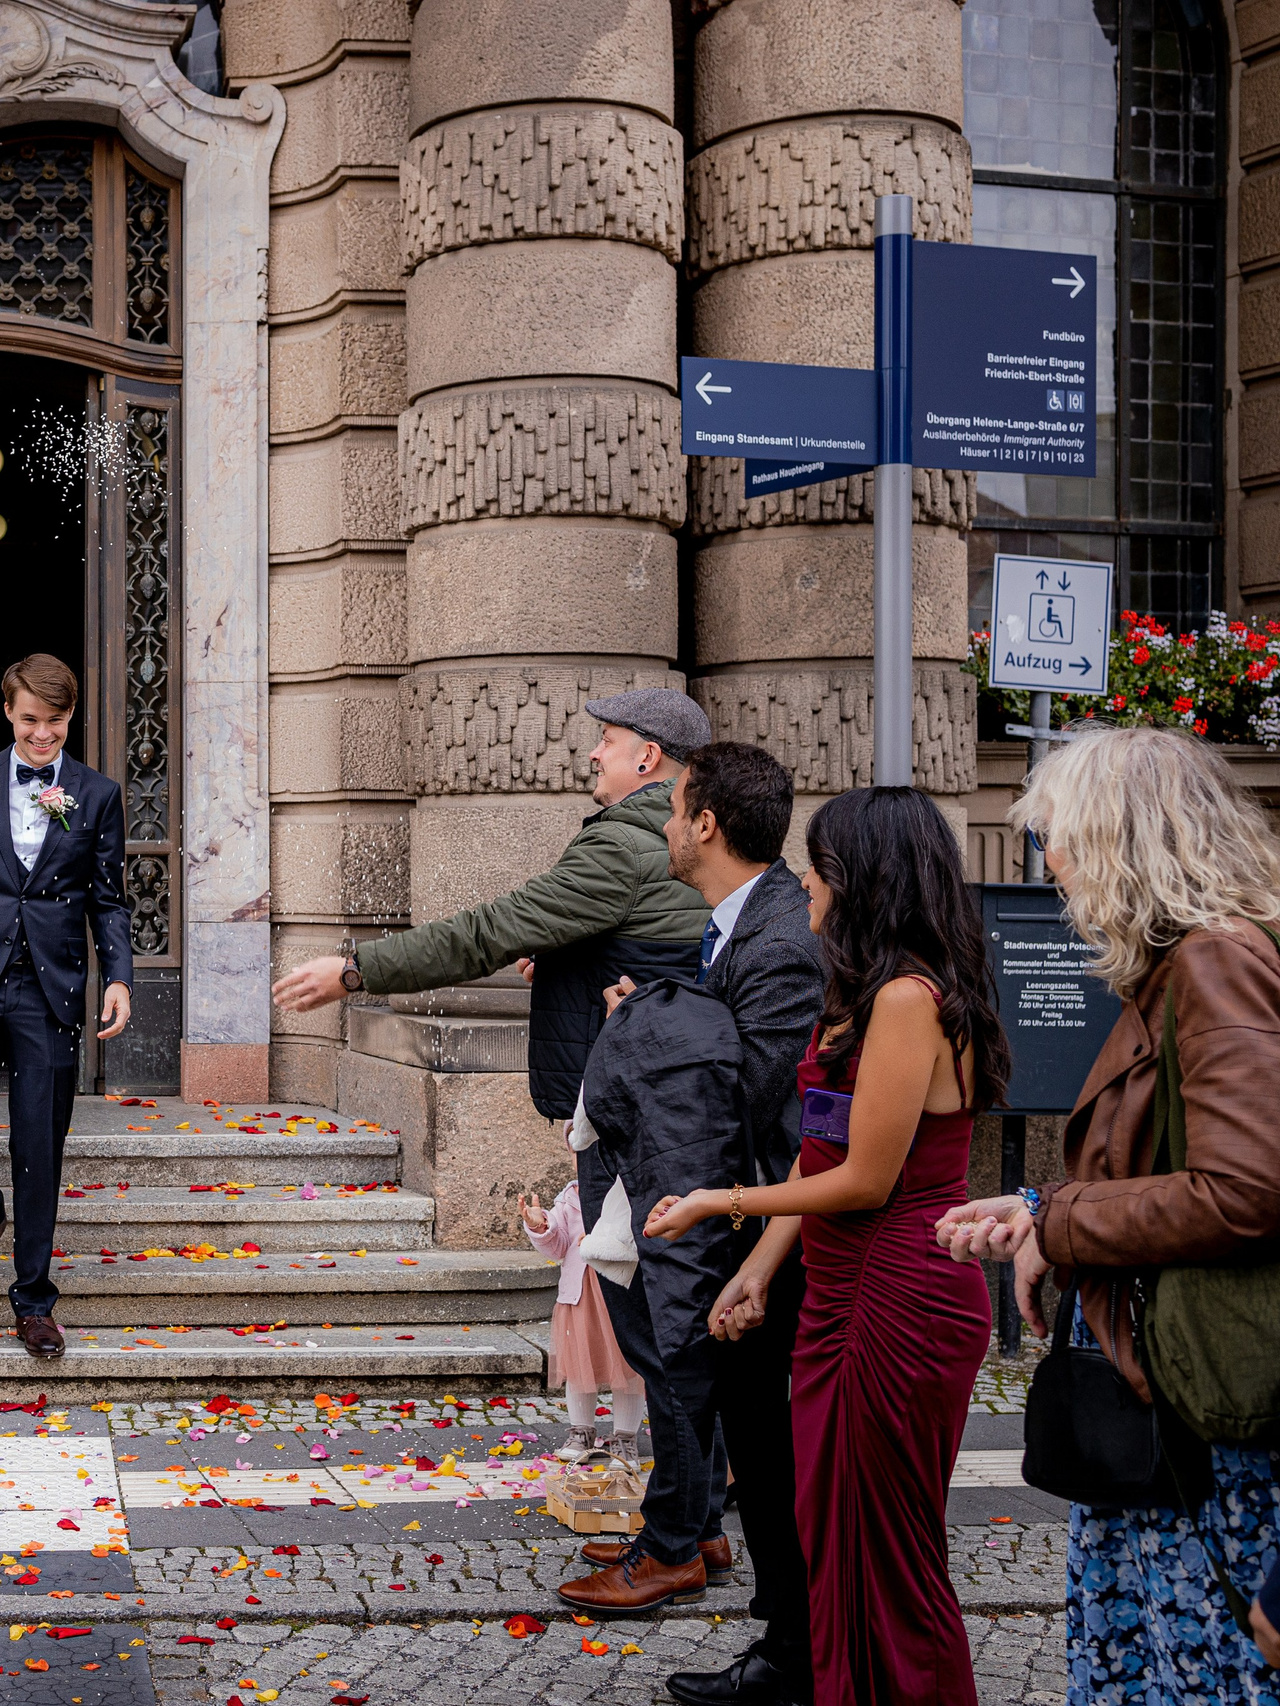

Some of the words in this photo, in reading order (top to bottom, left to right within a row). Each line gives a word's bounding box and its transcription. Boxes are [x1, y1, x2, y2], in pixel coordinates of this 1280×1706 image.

[1042, 330, 1085, 343] Fundbüro
[987, 352, 1047, 366] Barrierefreier
[1049, 357, 1085, 370] Eingang
[985, 368, 1085, 384] Friedrich-Ebert-Straße
[926, 412, 970, 428] Übergang
[973, 416, 1068, 432] Helene-Lange-Straße
[1069, 422, 1084, 433] 6/7
[696, 431, 734, 444] Eingang
[737, 433, 793, 446] Standesamt
[800, 437, 866, 450] Urkundenstelle
[923, 429, 1000, 443] Ausländerbehörde
[1004, 434, 1046, 446] Immigrant
[1046, 436, 1084, 450] Authority
[960, 446, 990, 458] Häuser
[993, 449, 997, 458] 1
[1005, 450, 1011, 459] 2
[1018, 450, 1024, 459] 6
[1031, 450, 1036, 460] 7
[1043, 451, 1049, 461] 9
[1056, 452, 1067, 462] 10
[1073, 453, 1084, 463] 23
[752, 472, 778, 485] Rathaus
[779, 461, 824, 478] Haupteingang
[1004, 651, 1062, 674] Aufzug
[1004, 941, 1067, 952] Stadtverwaltung
[1026, 982, 1079, 990] Leerungszeiten
[1042, 1011, 1062, 1019] Freitag
